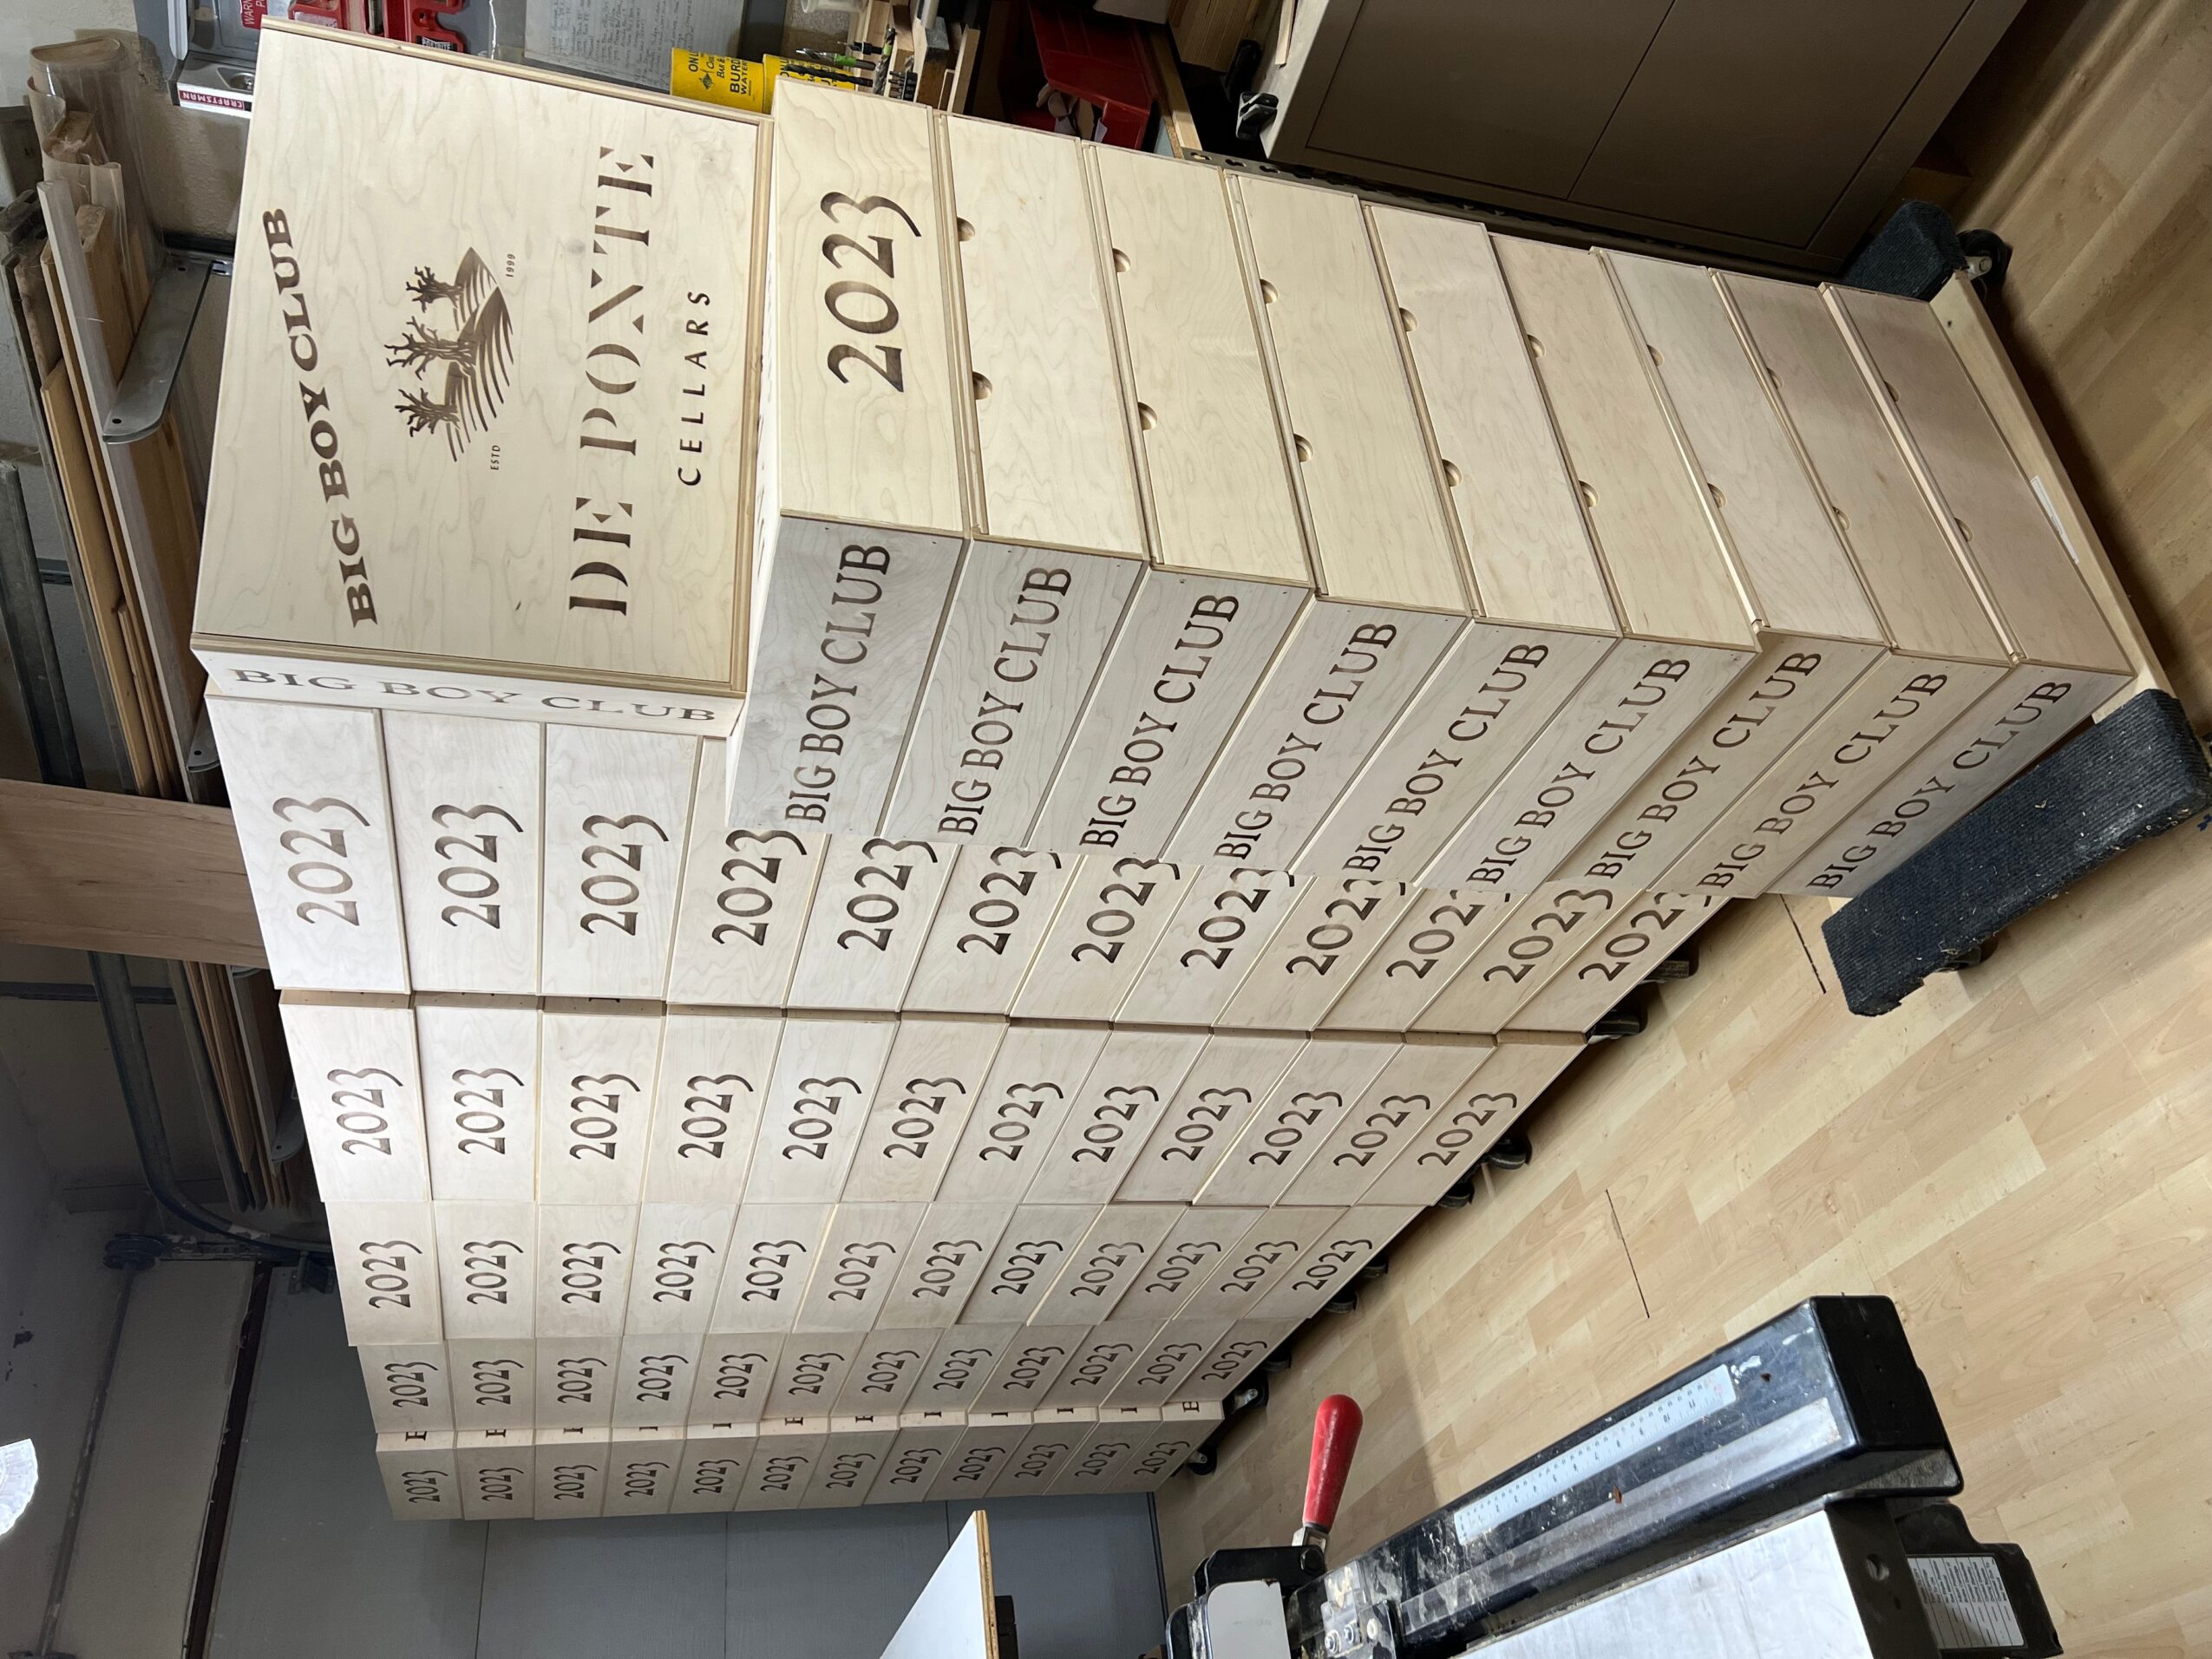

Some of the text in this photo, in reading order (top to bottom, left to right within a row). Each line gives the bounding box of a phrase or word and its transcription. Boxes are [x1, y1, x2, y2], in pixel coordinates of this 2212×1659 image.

[182, 91, 243, 108] CRAFTSMAN
[504, 253, 516, 278] 1999
[820, 192, 921, 393] 2023
[580, 147, 653, 455] PONTE
[262, 209, 377, 627] BIG BOY CLUB
[677, 292, 710, 486] CELLARS
[488, 444, 501, 471] ESTD
[569, 497, 632, 616] DE
[229, 669, 716, 721] BIG BOY CLUB
[785, 545, 890, 823] BIG BOY CLUB
[938, 568, 1071, 835] BIG BOY CLUB
[1079, 596, 1239, 847] BIG BOY CLUB
[1214, 624, 1397, 859] BIG BOY CLUB
[1342, 645, 1548, 872] BIG BOY CLUB
[1466, 659, 1690, 884] BIG BOY CLUB
[1585, 653, 1821, 878] BIG BOY CLUB
[1697, 675, 1947, 888] BIG BOY CLUB
[1806, 683, 2071, 889] BIG BOY CLUB
[272, 798, 370, 926] 2023
[432, 805, 523, 929] 2023
[580, 815, 669, 936] 2023
[712, 830, 807, 946] 2023
[837, 839, 938, 951] 2023
[956, 846, 1062, 955] 2023
[1070, 857, 1181, 963] 2023
[1385, 889, 1510, 979] 202
[1482, 888, 1613, 983] 2023
[327, 1067, 404, 1154] 2023
[452, 1068, 524, 1154] 2023
[570, 1074, 640, 1159] 2023
[678, 1074, 754, 1159] 2023
[782, 1077, 861, 1159] 2023
[883, 1078, 965, 1158] 2023
[979, 1082, 1063, 1161] 2023
[1071, 1086, 1159, 1162] 2023
[1162, 1087, 1252, 1161] 2023
[1249, 1092, 1342, 1165] 2023
[1333, 1095, 1430, 1166] 2023
[1417, 1094, 1517, 1166] 2023
[360, 1241, 422, 1308] 2023
[463, 1241, 523, 1304] 2023
[561, 1242, 621, 1303] 2023
[653, 1242, 715, 1302] 2023
[742, 1240, 807, 1301] 2023
[828, 1242, 896, 1301] 2023
[913, 1240, 982, 1297] 2023
[991, 1241, 1063, 1295] 2023
[1070, 1243, 1144, 1297] 2023
[1145, 1242, 1221, 1292] 2023
[1221, 1241, 1298, 1291] 2023
[1292, 1239, 1372, 1290] 2023
[384, 1362, 438, 1408] 2023
[473, 1360, 524, 1405] 2023
[558, 1358, 607, 1403] 2023
[637, 1355, 689, 1401] 2023
[714, 1354, 768, 1399] 2023
[789, 1353, 844, 1394] 2023
[861, 1350, 919, 1393] 2023
[933, 1349, 992, 1390] 2023
[1003, 1347, 1064, 1389] 2023
[1070, 1344, 1133, 1386] 2023
[1137, 1343, 1201, 1385] 2023
[1201, 1341, 1267, 1381] 2023
[402, 1471, 448, 1503] 2023
[479, 1467, 524, 1501] 2023
[554, 1465, 598, 1499] 2023
[625, 1462, 670, 1497] 2023
[693, 1460, 740, 1493] 2023
[760, 1457, 808, 1492] 2023
[826, 1453, 876, 1488] 2023
[890, 1448, 941, 1484] 2023
[952, 1447, 1005, 1481] 2023
[1014, 1444, 1069, 1478] 2023
[1075, 1443, 1130, 1476] 2023
[1134, 1441, 1190, 1474] 2023
